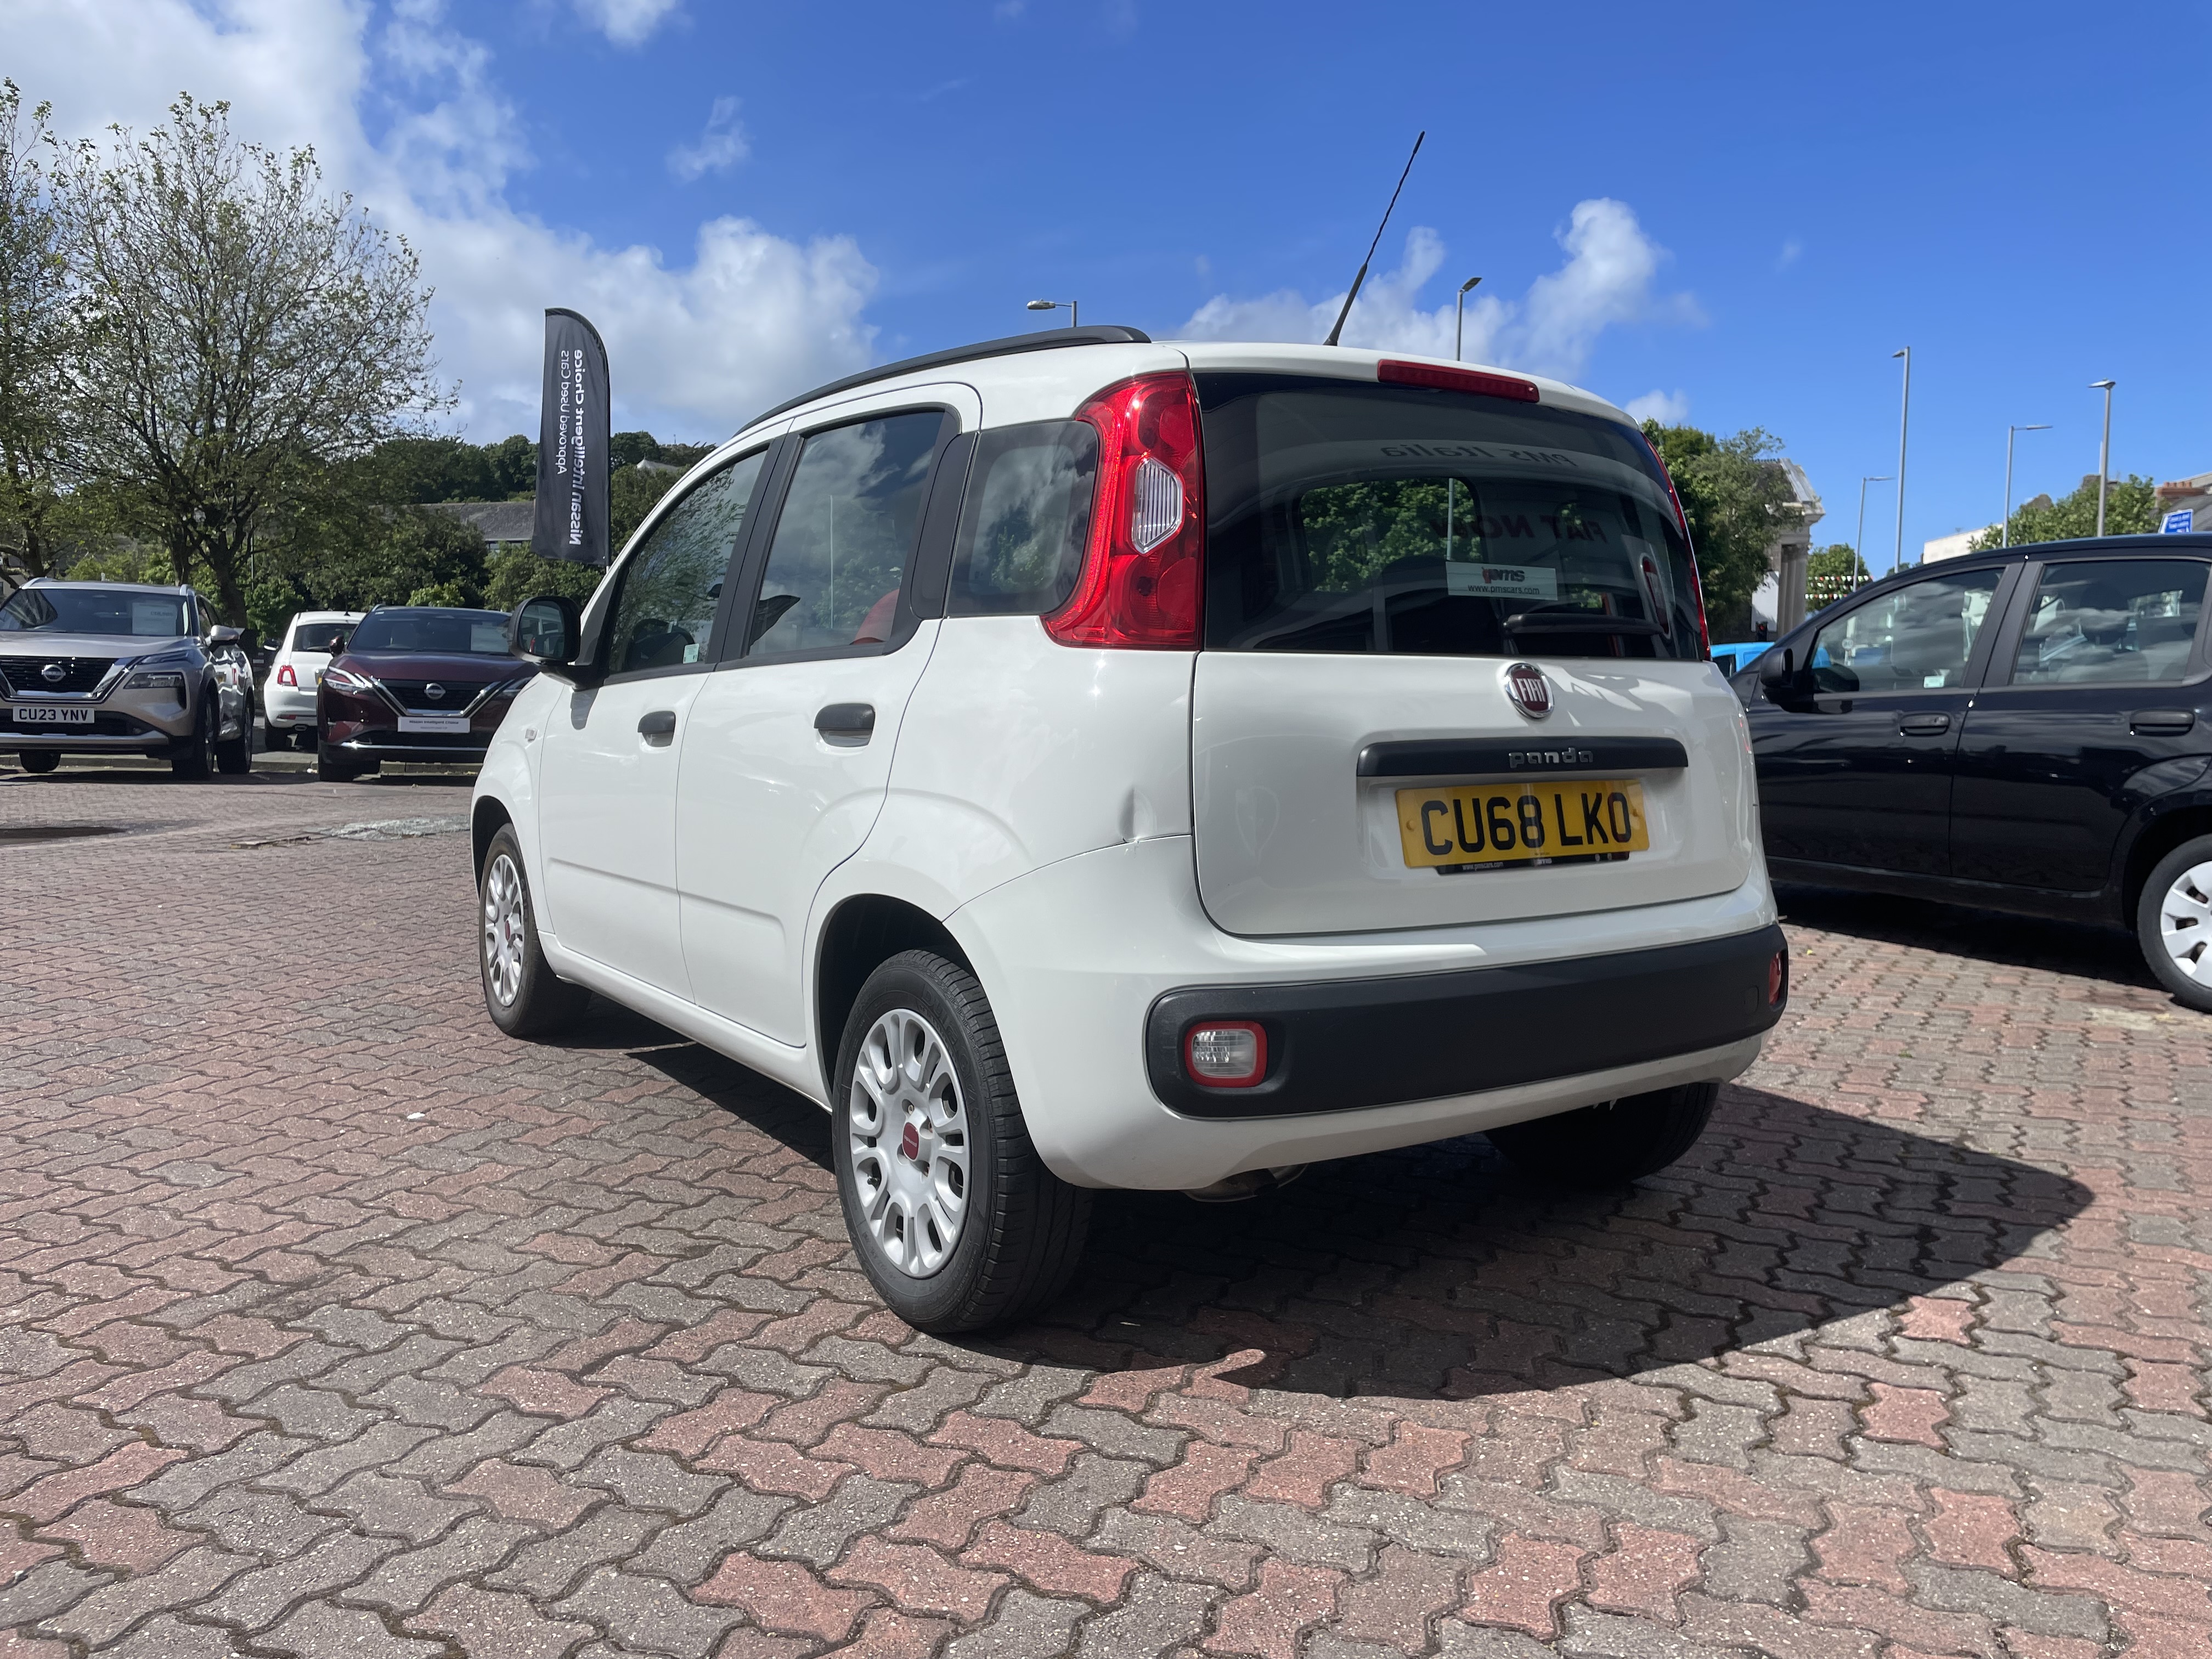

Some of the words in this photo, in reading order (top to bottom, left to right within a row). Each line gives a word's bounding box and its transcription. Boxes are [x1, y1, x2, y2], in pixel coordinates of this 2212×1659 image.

[1468, 585, 1541, 595] www.pmscars.com
[1516, 678, 1546, 702] FIAT
[19, 708, 57, 720] CU23
[61, 709, 88, 721] YNV
[1509, 747, 1594, 769] panda
[1421, 794, 1545, 856] CU68
[1554, 792, 1632, 847] LKO
